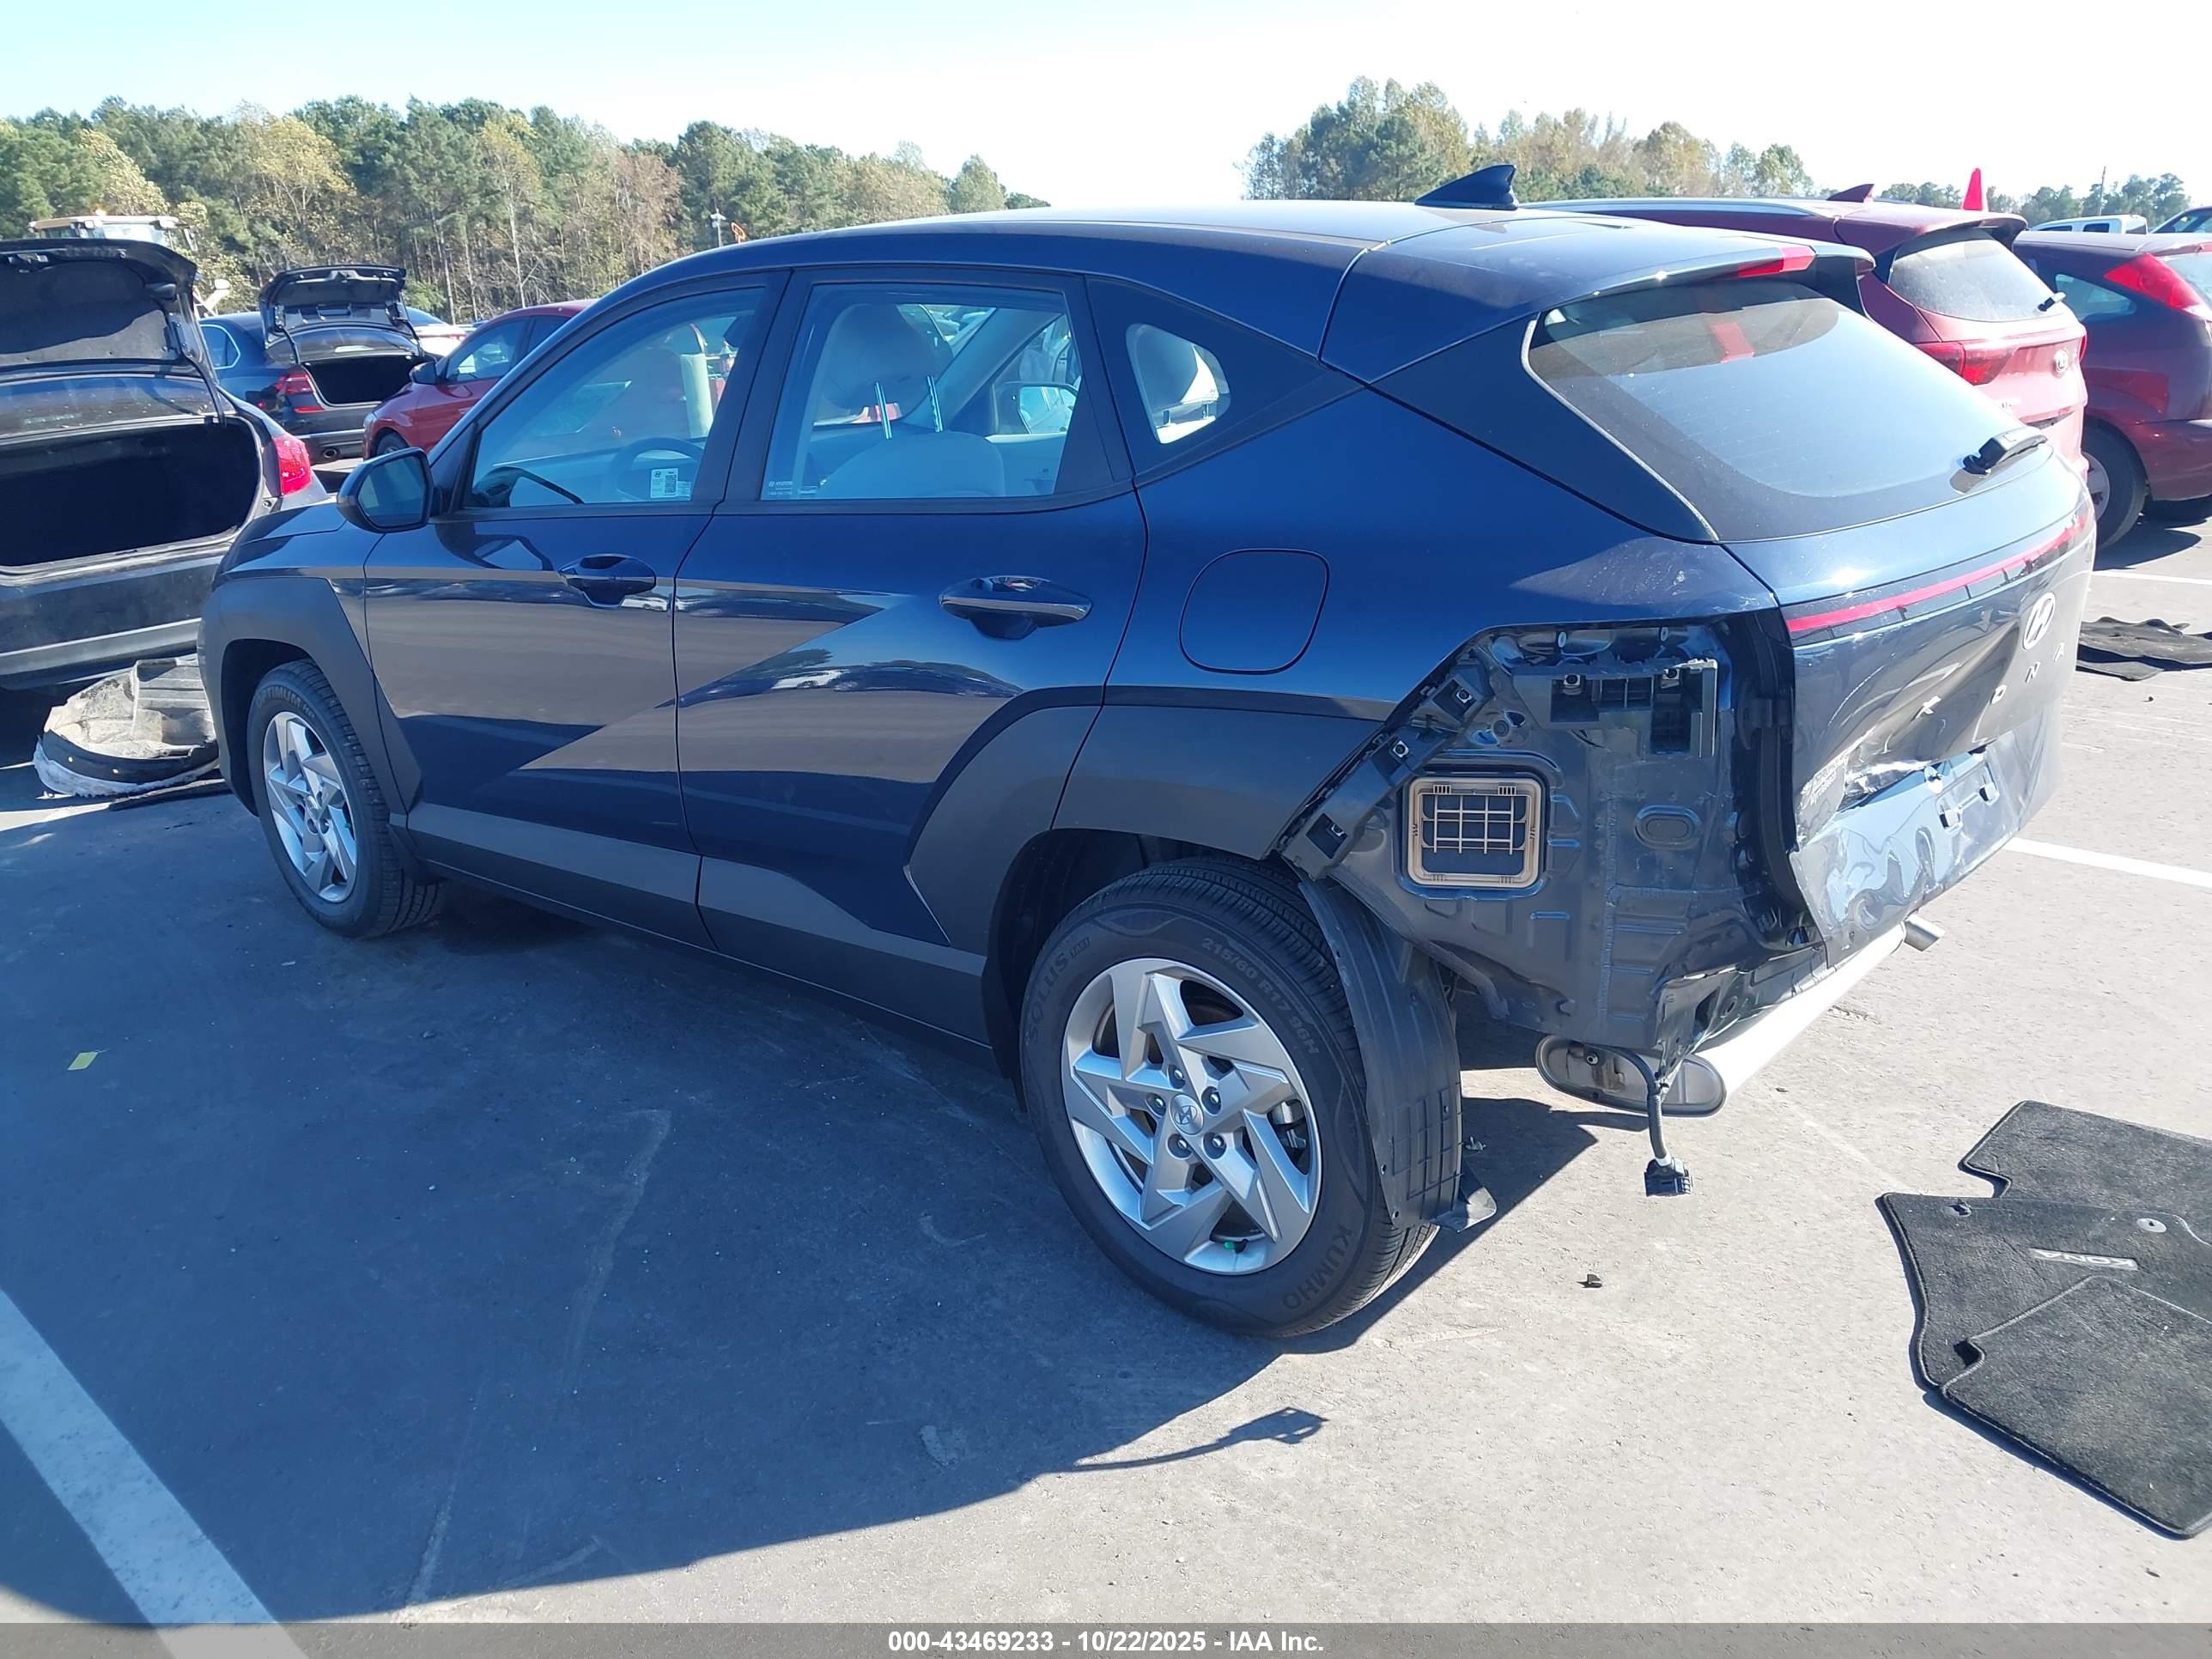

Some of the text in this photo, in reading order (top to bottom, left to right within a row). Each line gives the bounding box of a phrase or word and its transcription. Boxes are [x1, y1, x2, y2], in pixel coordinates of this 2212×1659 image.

[1027, 951, 1069, 1042] SOLUS
[1202, 937, 1320, 1055] 215/60 R17 96H
[1283, 1224, 1354, 1310] KUMHO
[2032, 1249, 2136, 1267] KONA
